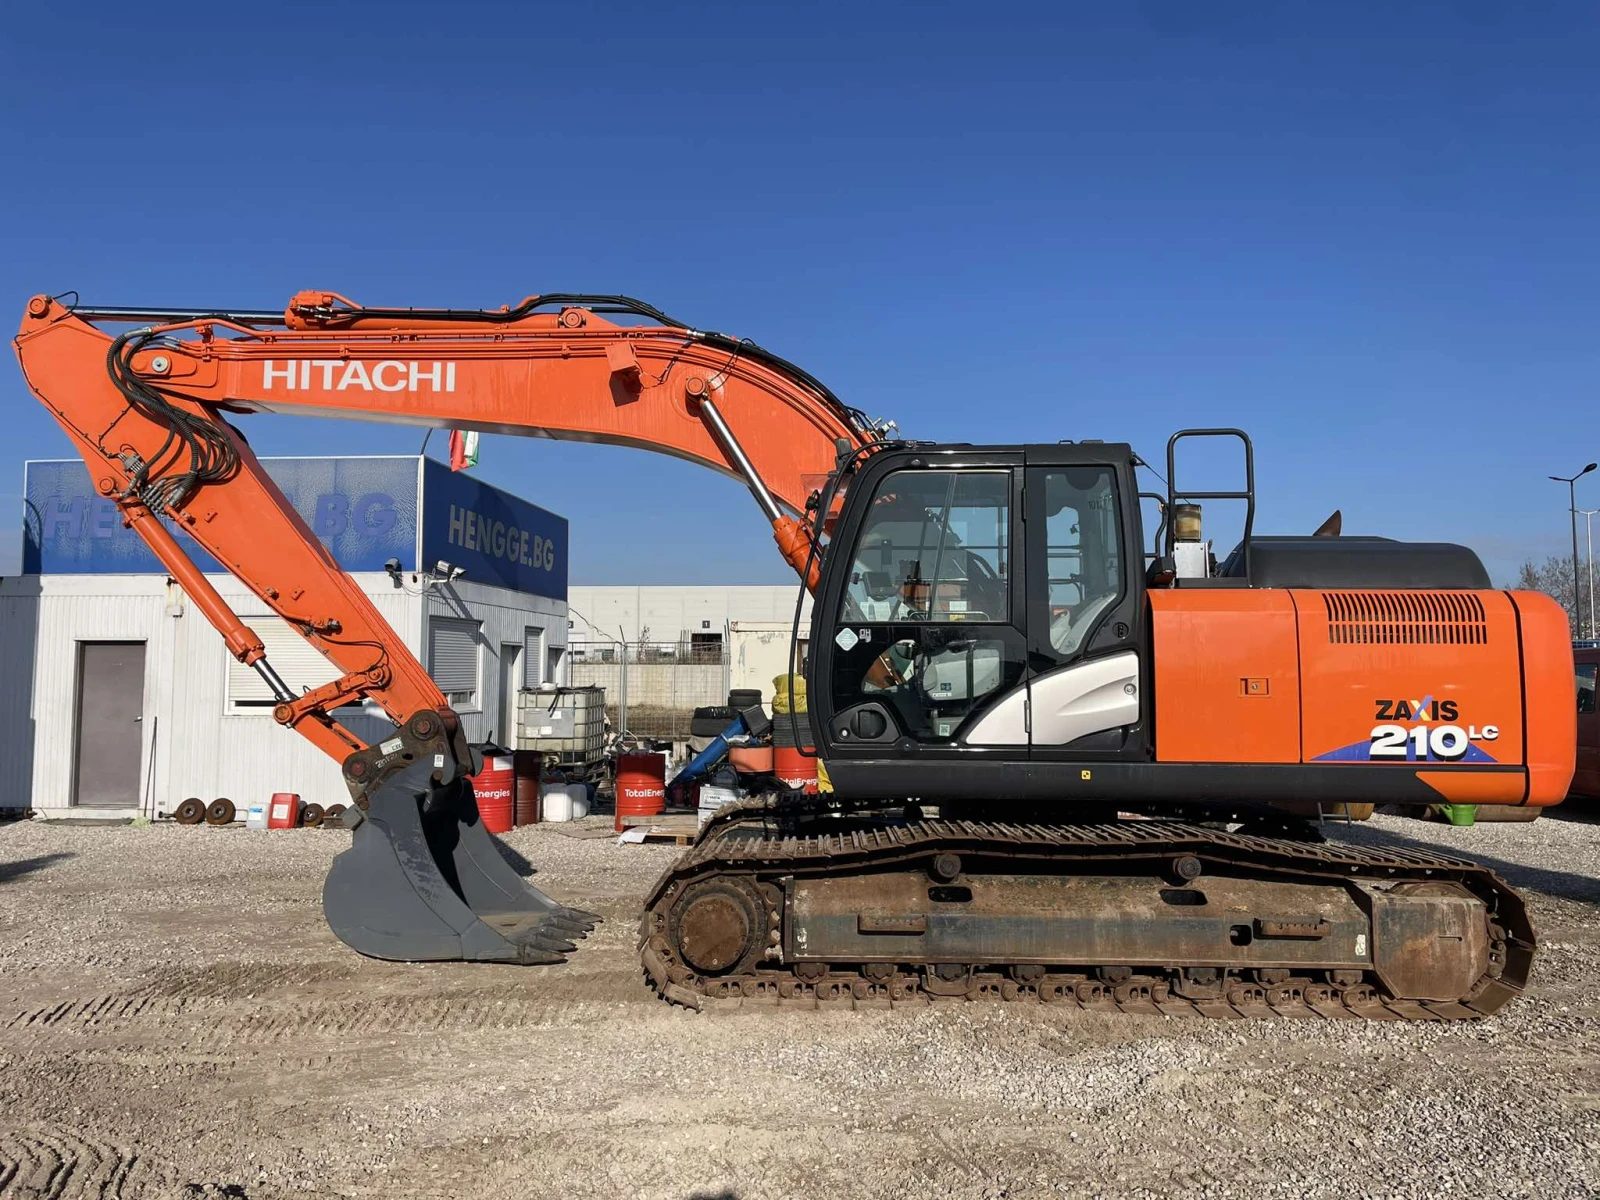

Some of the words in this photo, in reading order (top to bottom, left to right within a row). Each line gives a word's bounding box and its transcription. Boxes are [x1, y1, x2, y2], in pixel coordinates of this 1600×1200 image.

[263, 359, 456, 392] HITACHI
[448, 503, 554, 572] HENGGE.BG
[1375, 695, 1459, 721] ZAXIS
[474, 788, 510, 799] Energies
